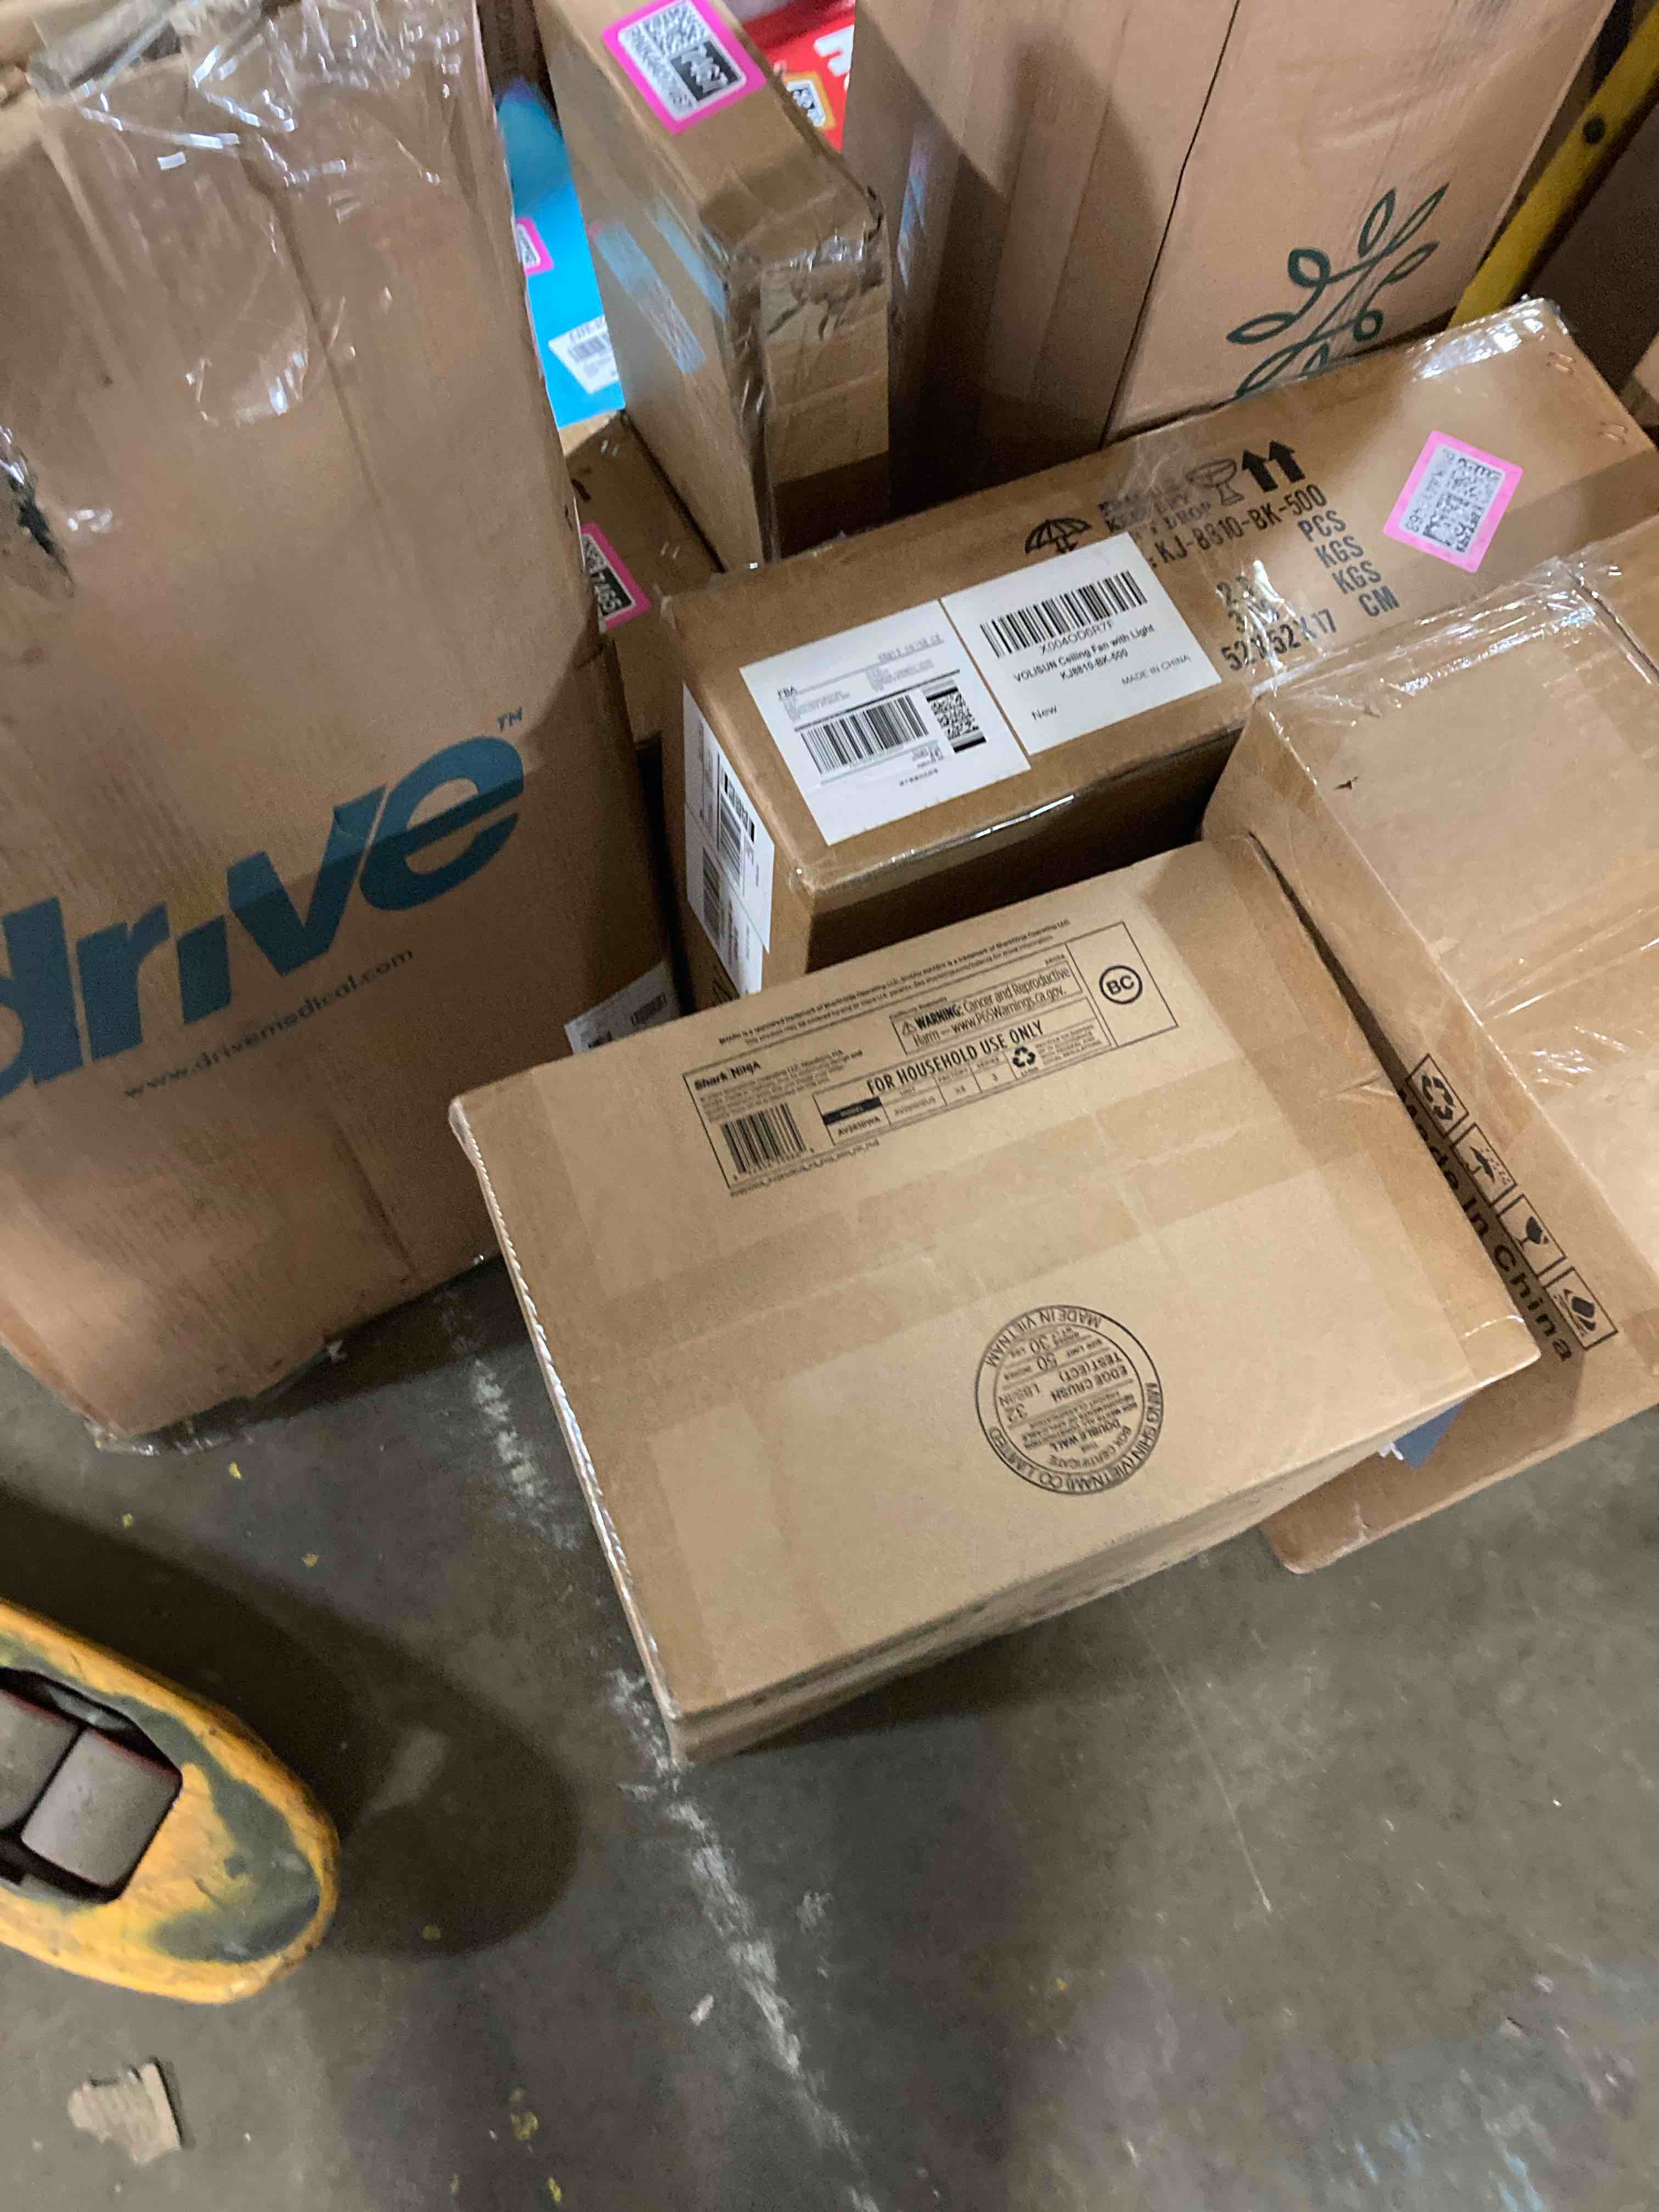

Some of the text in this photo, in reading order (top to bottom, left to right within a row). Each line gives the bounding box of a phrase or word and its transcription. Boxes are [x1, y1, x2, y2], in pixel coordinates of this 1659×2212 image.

[1299, 509, 1347, 541] PCS
[1316, 536, 1364, 569] KGS
[1334, 561, 1381, 594] KGS
[1358, 585, 1401, 617] CM
[1056, 647, 1092, 668] Ceiling
[1090, 640, 1110, 653] Fan
[1108, 631, 1131, 647] with
[1129, 622, 1157, 640] Light
[1120, 653, 1192, 686] MADE IN CHINA
[1030, 703, 1059, 720] New
[914, 963, 1072, 1031] WARNING: Cancer and Reproductive
[1105, 973, 1136, 996] BC
[123, 950, 414, 1097] www.drivemedical.com
[912, 1028, 941, 1047] Harm
[866, 1072, 898, 1097] FOR
[895, 1042, 979, 1086] HOUSEHOLD
[979, 1032, 1008, 1056] USE
[1007, 1018, 1046, 1045] ONLY
[1057, 1309, 1101, 1328] MADE
[1489, 1241, 1576, 1363] China
[1049, 1376, 1094, 1403] CRUSH
[1093, 1364, 1128, 1387] EDGE
[1049, 1418, 1121, 1453] DOUBLE WALL
